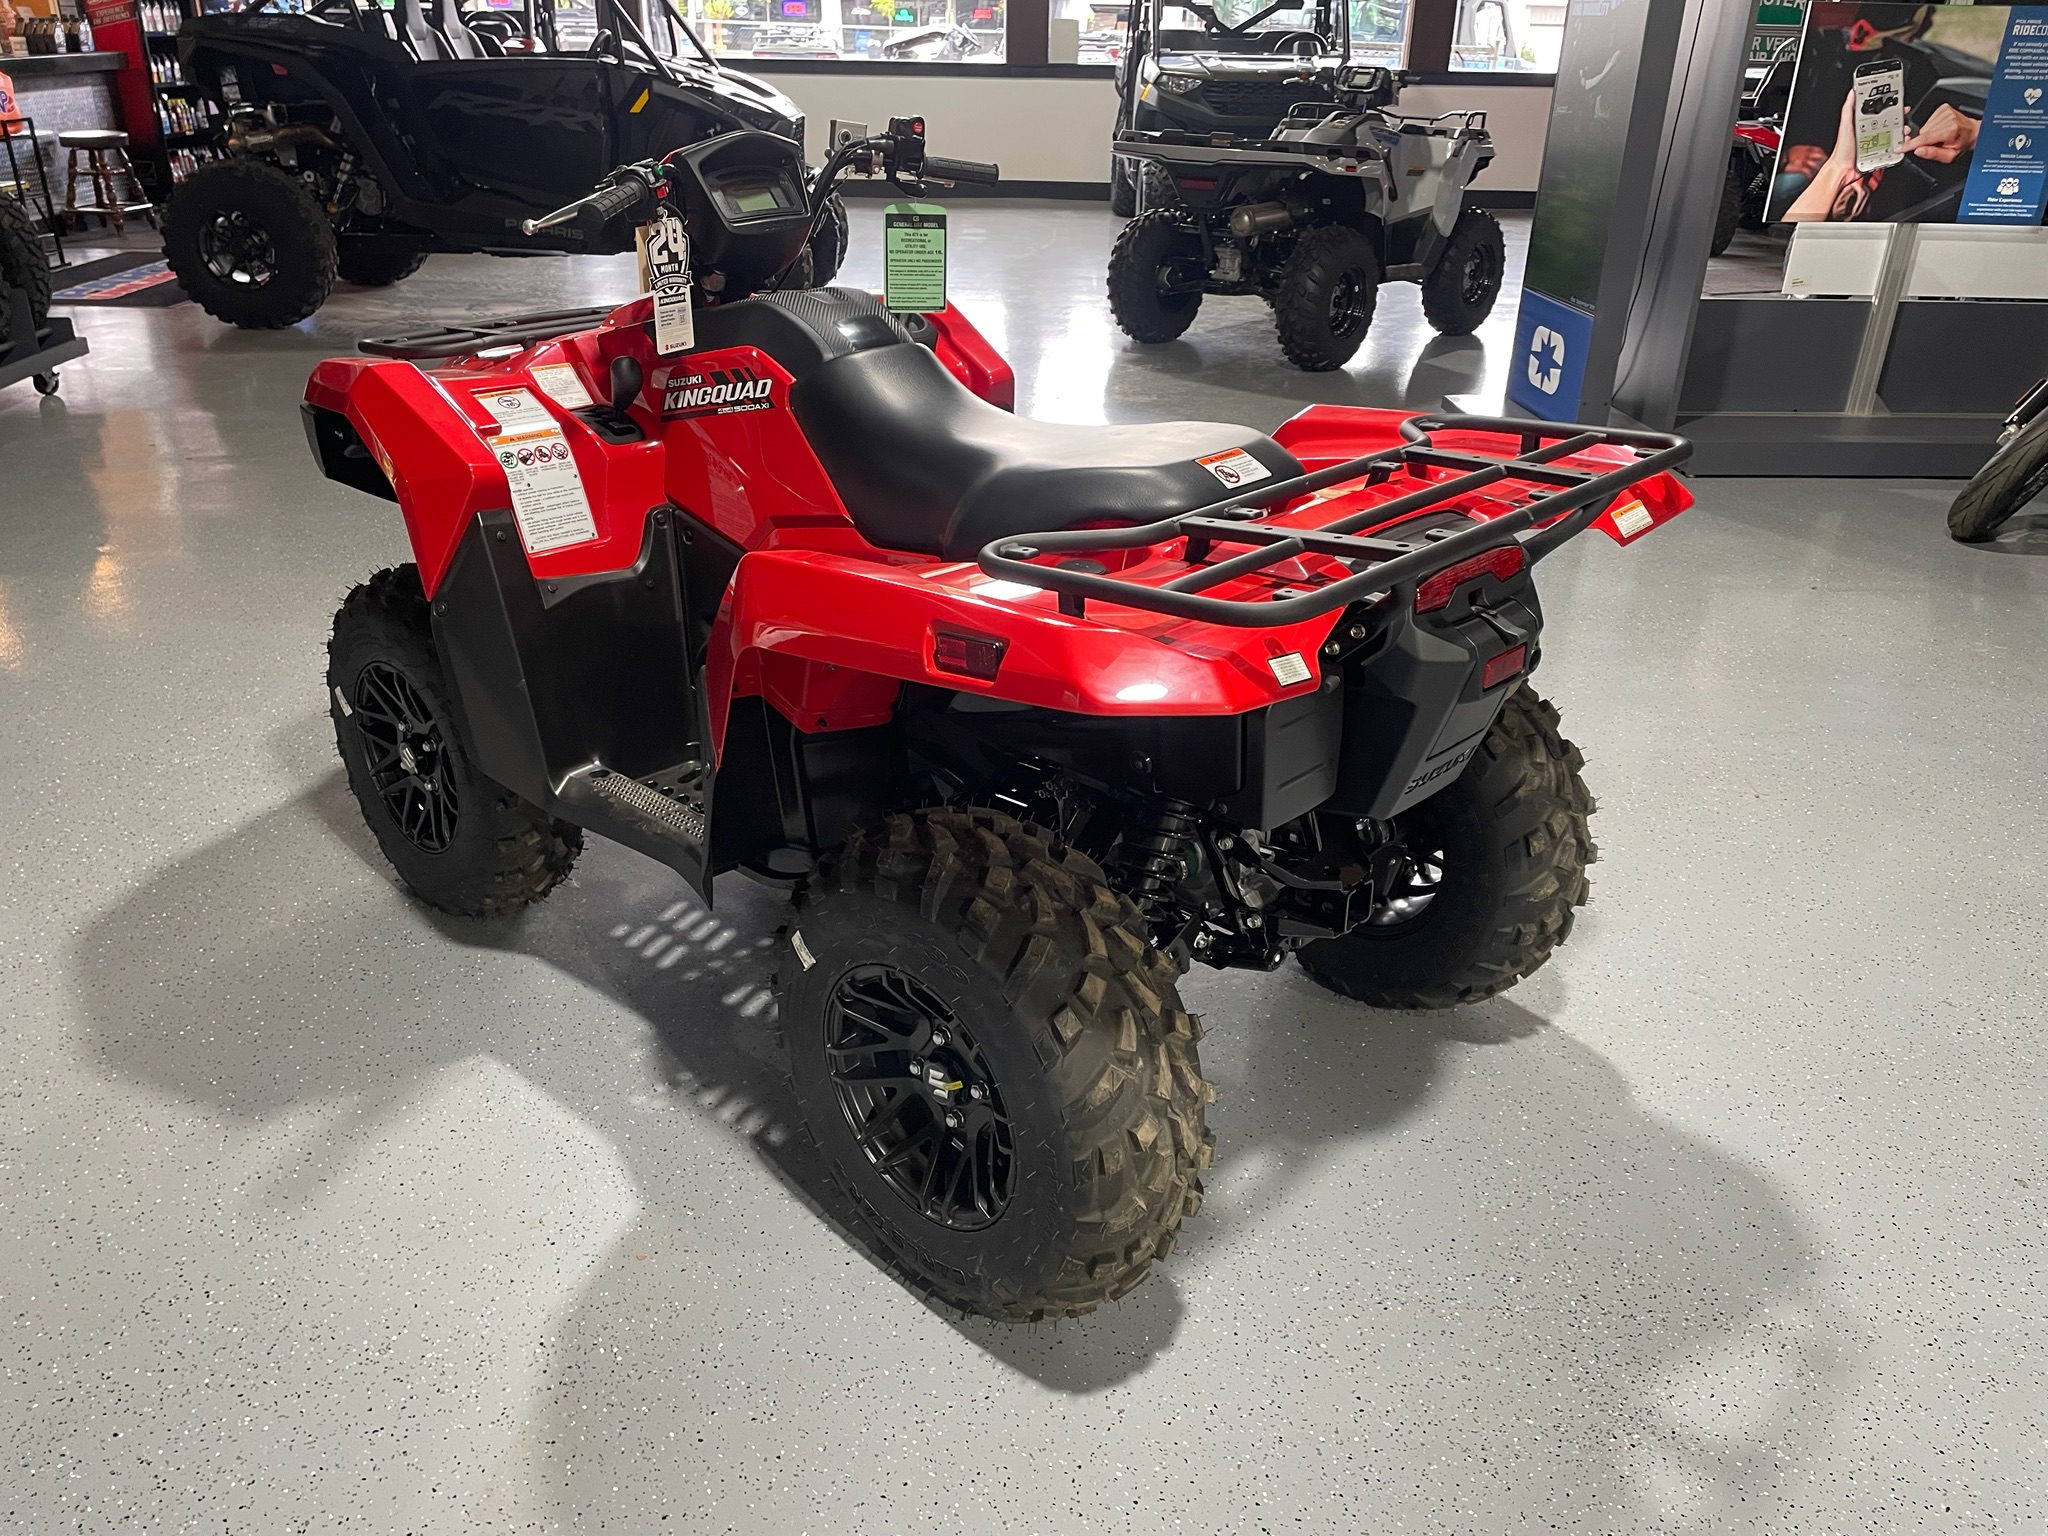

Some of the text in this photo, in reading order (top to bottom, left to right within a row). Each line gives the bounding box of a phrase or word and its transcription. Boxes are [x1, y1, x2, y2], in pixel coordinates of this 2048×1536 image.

[2012, 24, 2048, 36] RIDECO
[651, 217, 685, 265] 24
[661, 263, 679, 273] MONTH
[668, 375, 702, 387] SUZUKI
[664, 378, 773, 411] KINGQUAD
